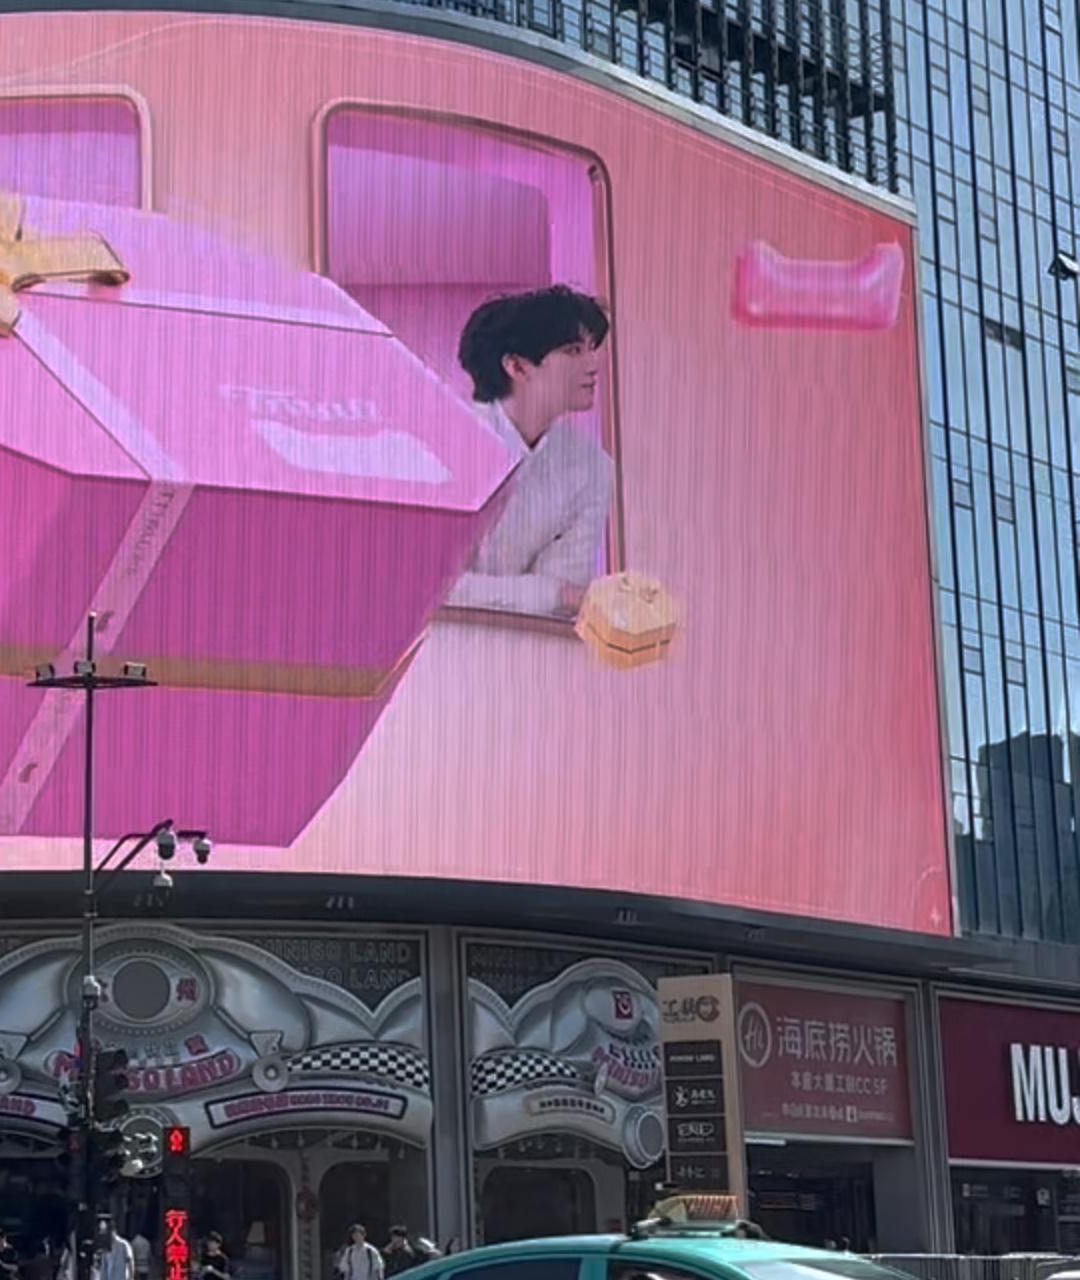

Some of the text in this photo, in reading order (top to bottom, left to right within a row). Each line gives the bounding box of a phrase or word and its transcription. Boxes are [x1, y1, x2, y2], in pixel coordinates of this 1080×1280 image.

[776, 1015, 898, 1068] 海底捞火锅
[166, 1052, 235, 1091] LAND
